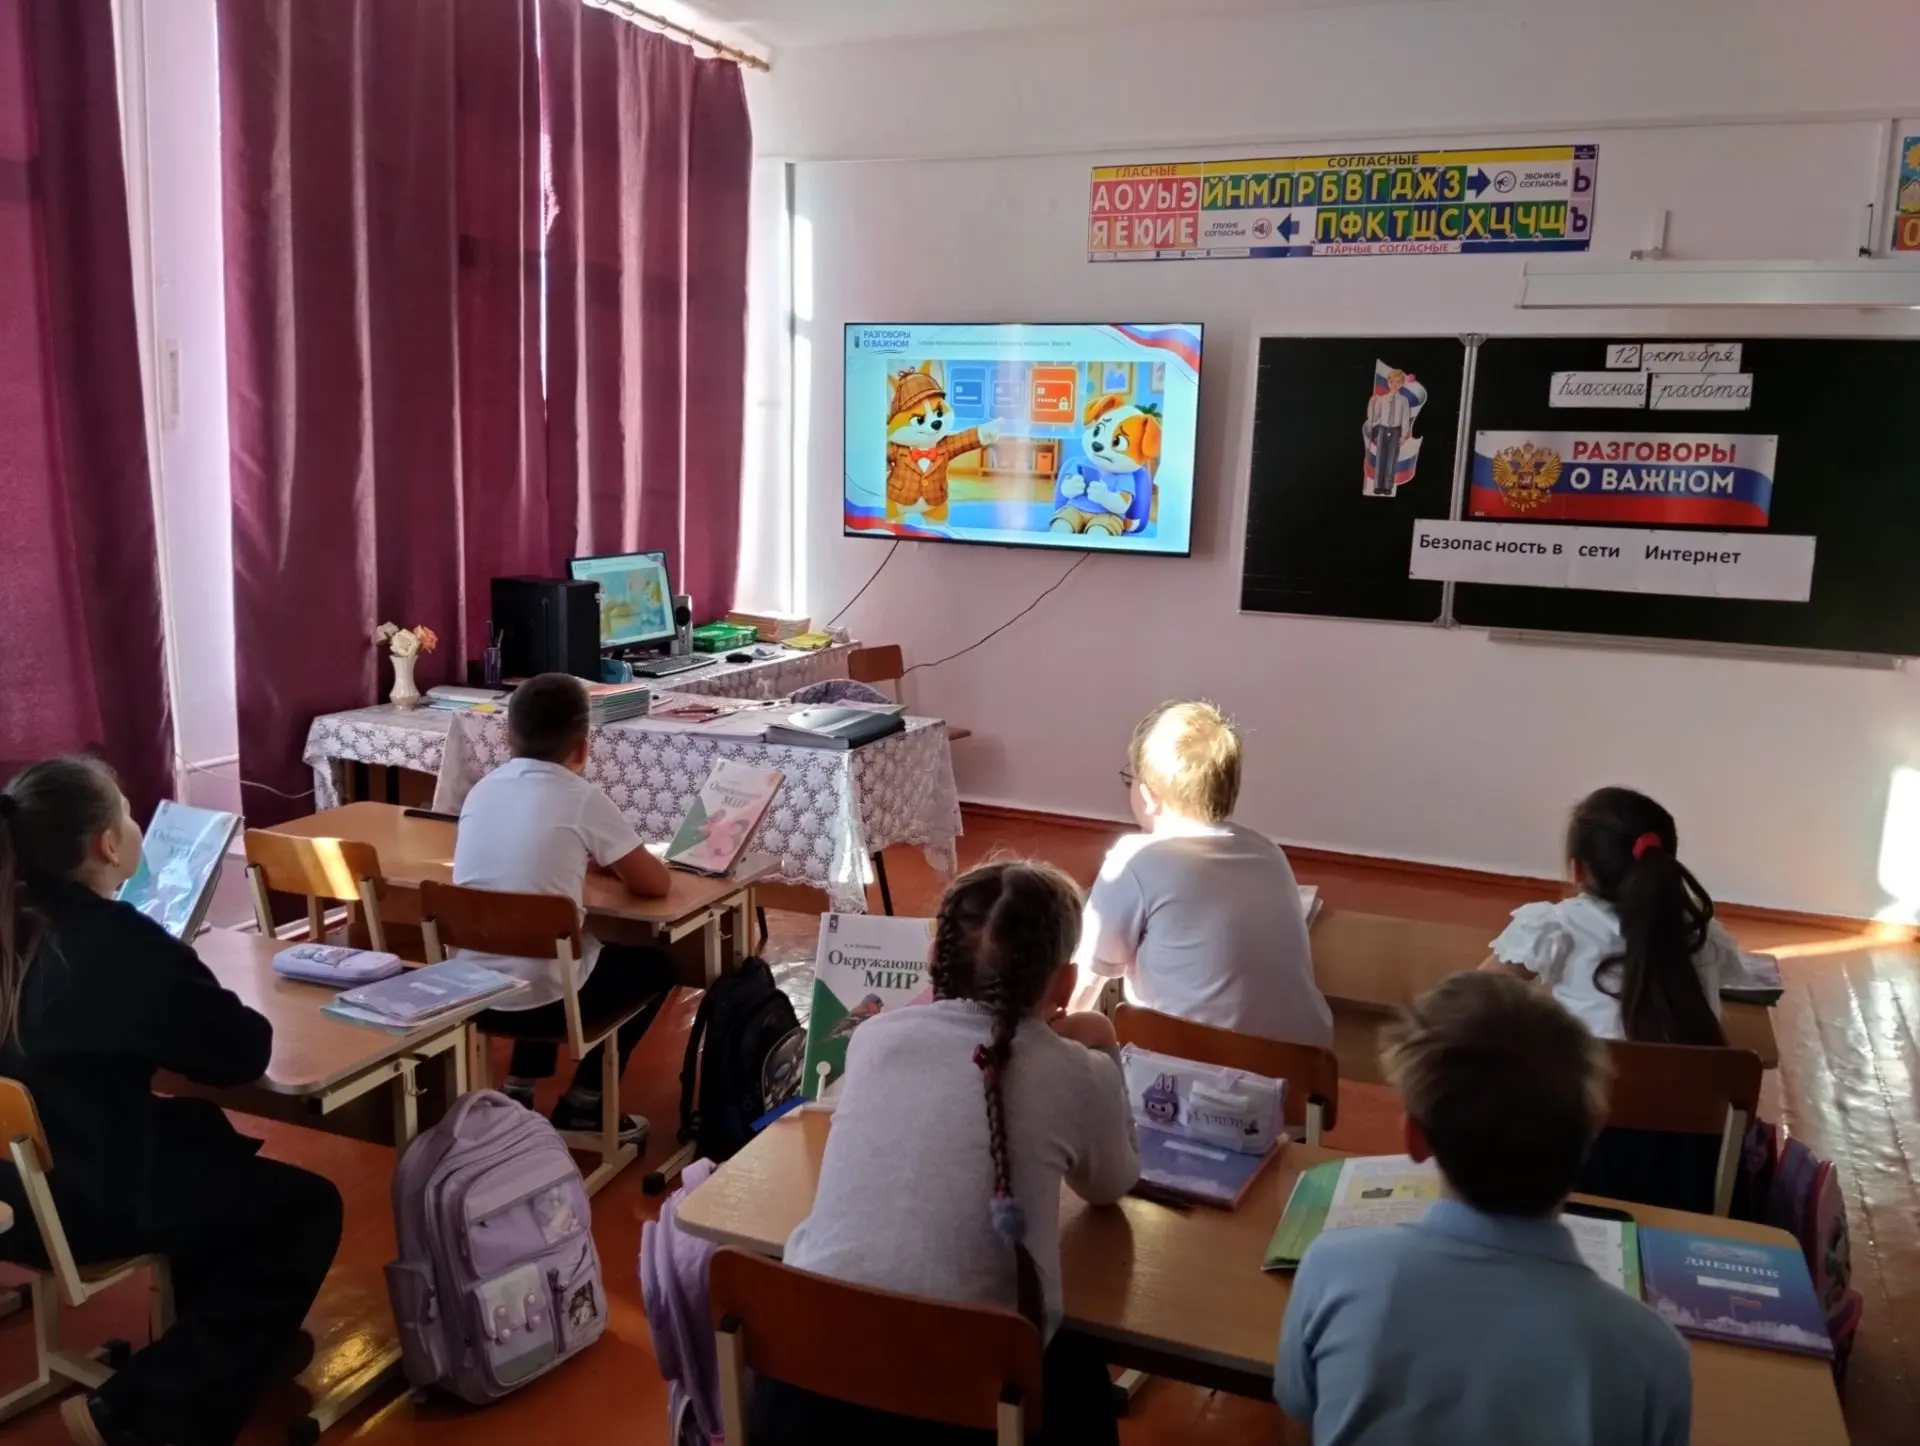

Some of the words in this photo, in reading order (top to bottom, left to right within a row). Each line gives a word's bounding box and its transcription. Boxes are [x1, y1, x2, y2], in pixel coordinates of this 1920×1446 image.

[1327, 154, 1420, 168] СОГЛАСНЫЕ
[1115, 165, 1177, 178] ГЛАСНЫЕ
[1523, 172, 1562, 181] ЗВОНКИЕ
[1519, 179, 1569, 189] СОГЛАСНЫЕ
[1211, 222, 1239, 231] ГЛУХИЕ
[1204, 229, 1247, 238] СОГЛАСНЫЕ
[1325, 244, 1373, 254] ПАРНЫЕ
[1378, 243, 1450, 254] СОГЛАСНЫЕ
[864, 331, 911, 339] РАЗГОВОРЫ
[871, 340, 910, 349] ВАЖНОМ
[1614, 346, 1639, 364] 12
[1643, 344, 1735, 372] октября
[1558, 373, 1646, 397] Классная
[1653, 374, 1751, 409] работа
[1572, 440, 1737, 464] РАЗГОВОРЫ
[1570, 467, 1591, 490] О
[1601, 468, 1734, 494] ВАЖНОМ
[1552, 544, 1563, 555] в
[1578, 544, 1620, 559] сети
[1645, 545, 1741, 566] Интернет
[864, 970, 920, 990] МИР
